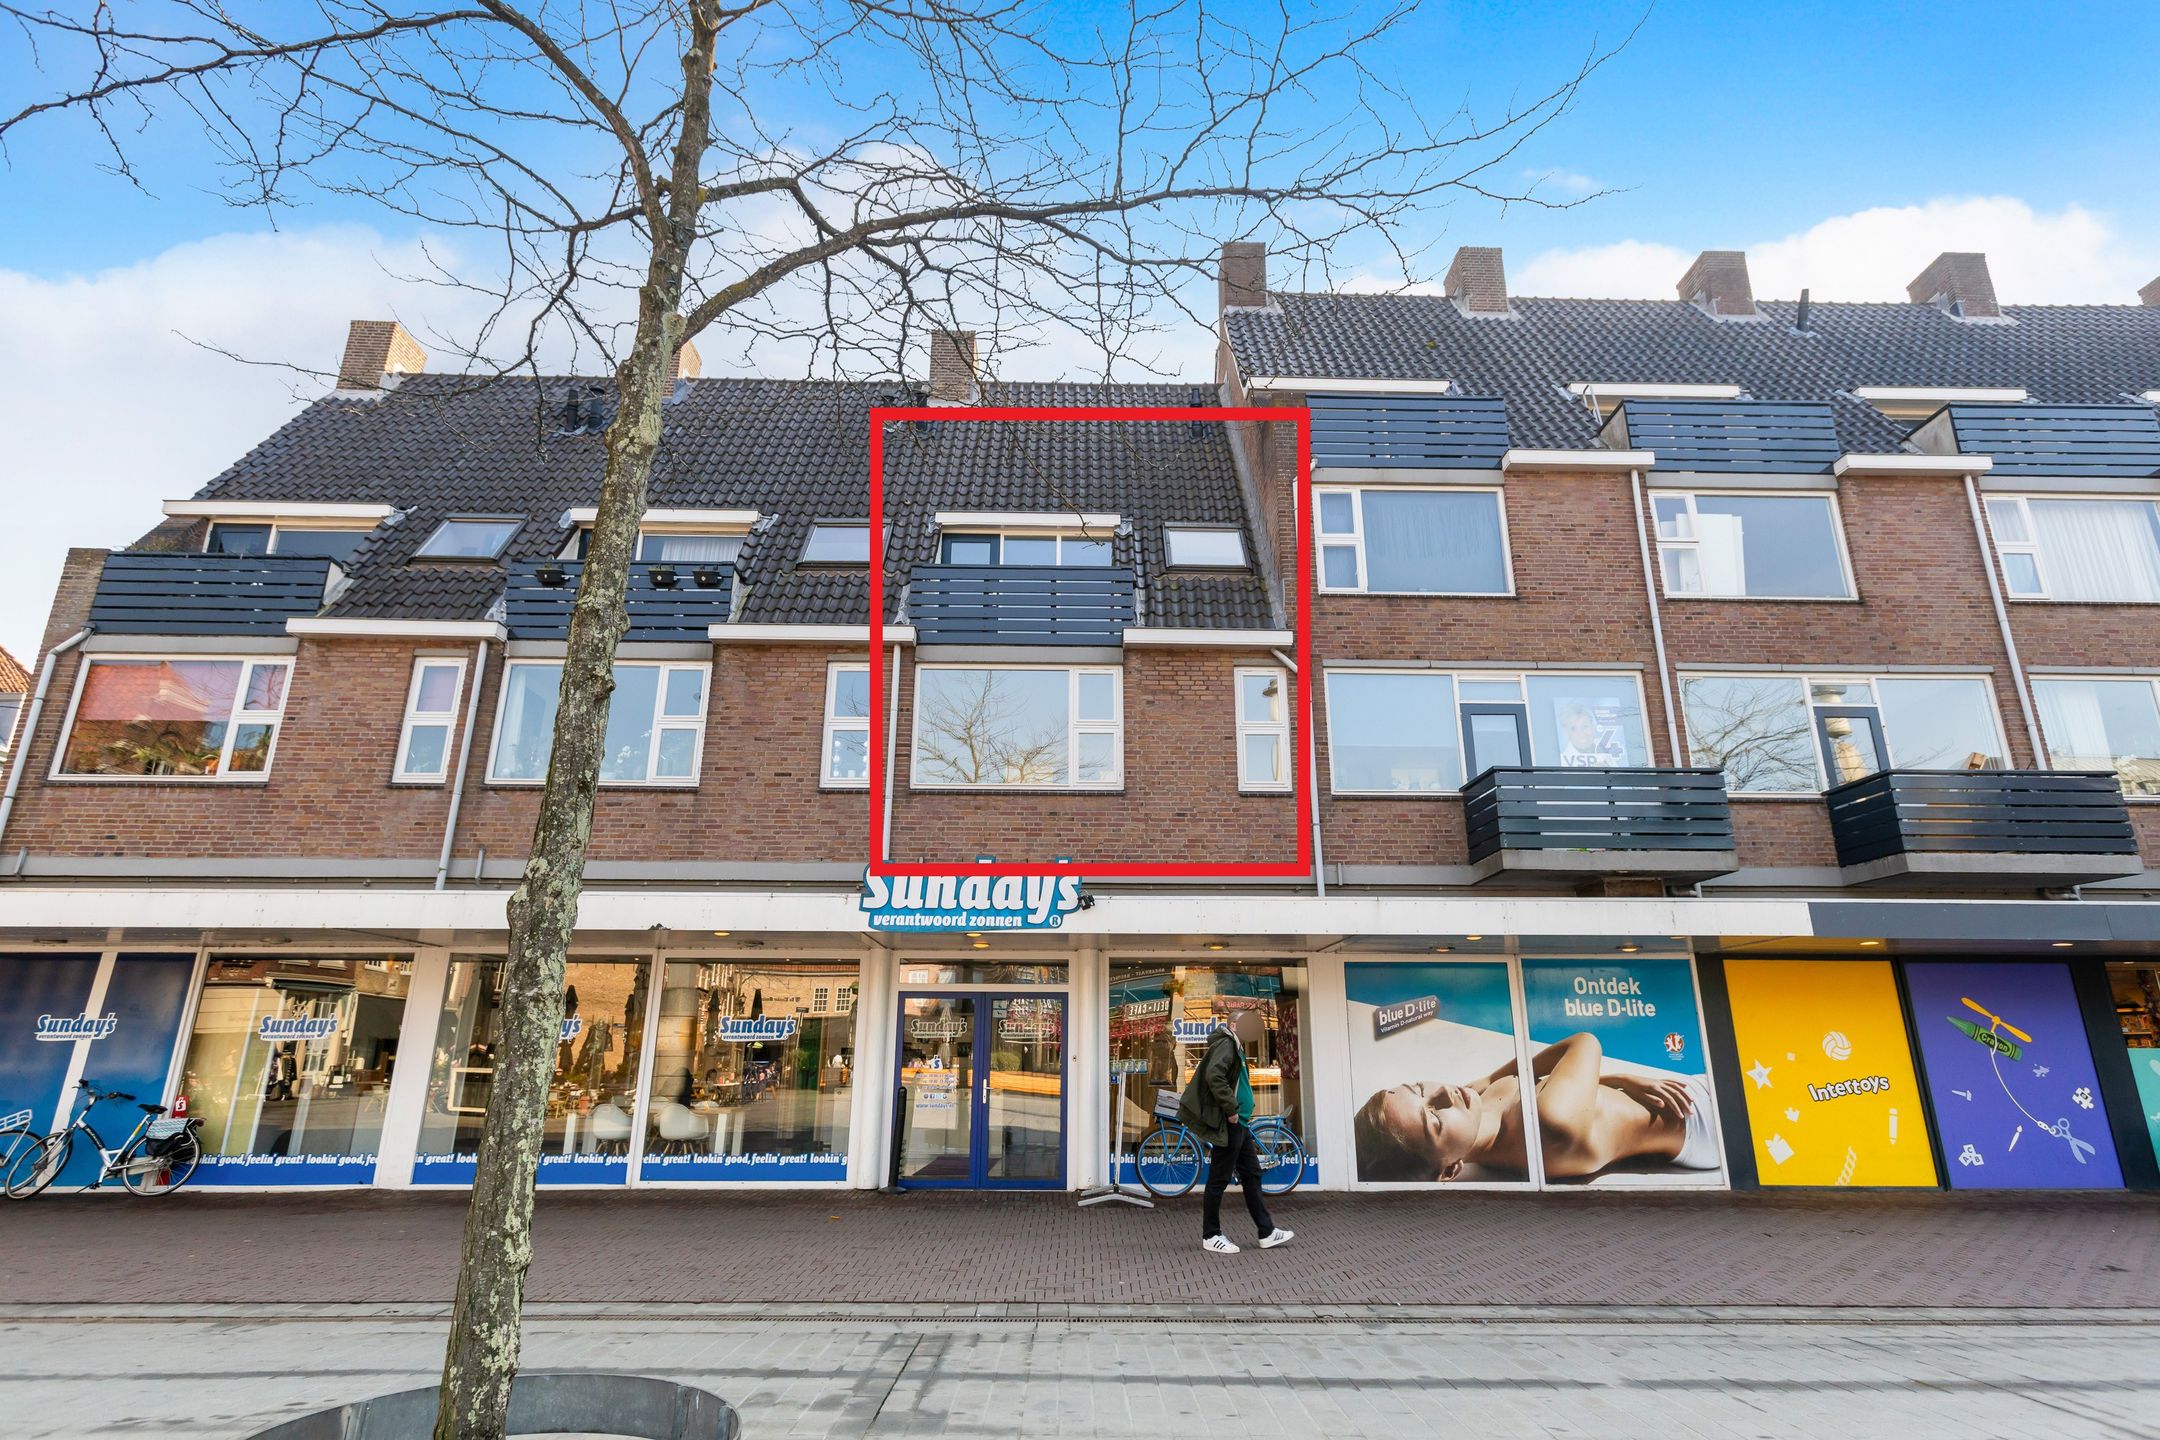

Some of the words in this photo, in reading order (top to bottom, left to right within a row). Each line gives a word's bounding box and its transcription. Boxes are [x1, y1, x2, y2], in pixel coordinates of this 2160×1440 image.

[862, 859, 1080, 924] Sundays
[873, 911, 966, 927] verantwoord
[969, 913, 1022, 927] zonnen
[1573, 976, 1642, 995] Ontdek
[1564, 998, 1604, 1017] blue
[1607, 998, 1656, 1017] D-lite
[38, 1012, 116, 1038] Sunday's
[260, 1014, 338, 1038] Sunday's
[720, 1014, 795, 1038] Sunday's
[1379, 1009, 1404, 1026] blue
[911, 1018, 968, 1036] Sunday's
[1981, 1033, 2008, 1051] Craon
[1807, 1076, 1891, 1102] Intertoys
[218, 1153, 246, 1167] good,
[245, 1153, 276, 1167] feelin'
[274, 1154, 304, 1167] great!
[307, 1153, 340, 1164] lookin'
[338, 1153, 365, 1167] good,
[364, 1153, 378, 1167] fe
[425, 1153, 455, 1166] great!
[456, 1152, 478, 1164] look
[542, 1154, 572, 1166] great!
[573, 1153, 607, 1164] lookin'
[662, 1153, 691, 1166] great!
[693, 1153, 726, 1164] lookin'
[724, 1153, 751, 1166] good,
[750, 1152, 780, 1166] feelin'
[778, 1153, 808, 1166] great!
[810, 1153, 842, 1164] lookin'
